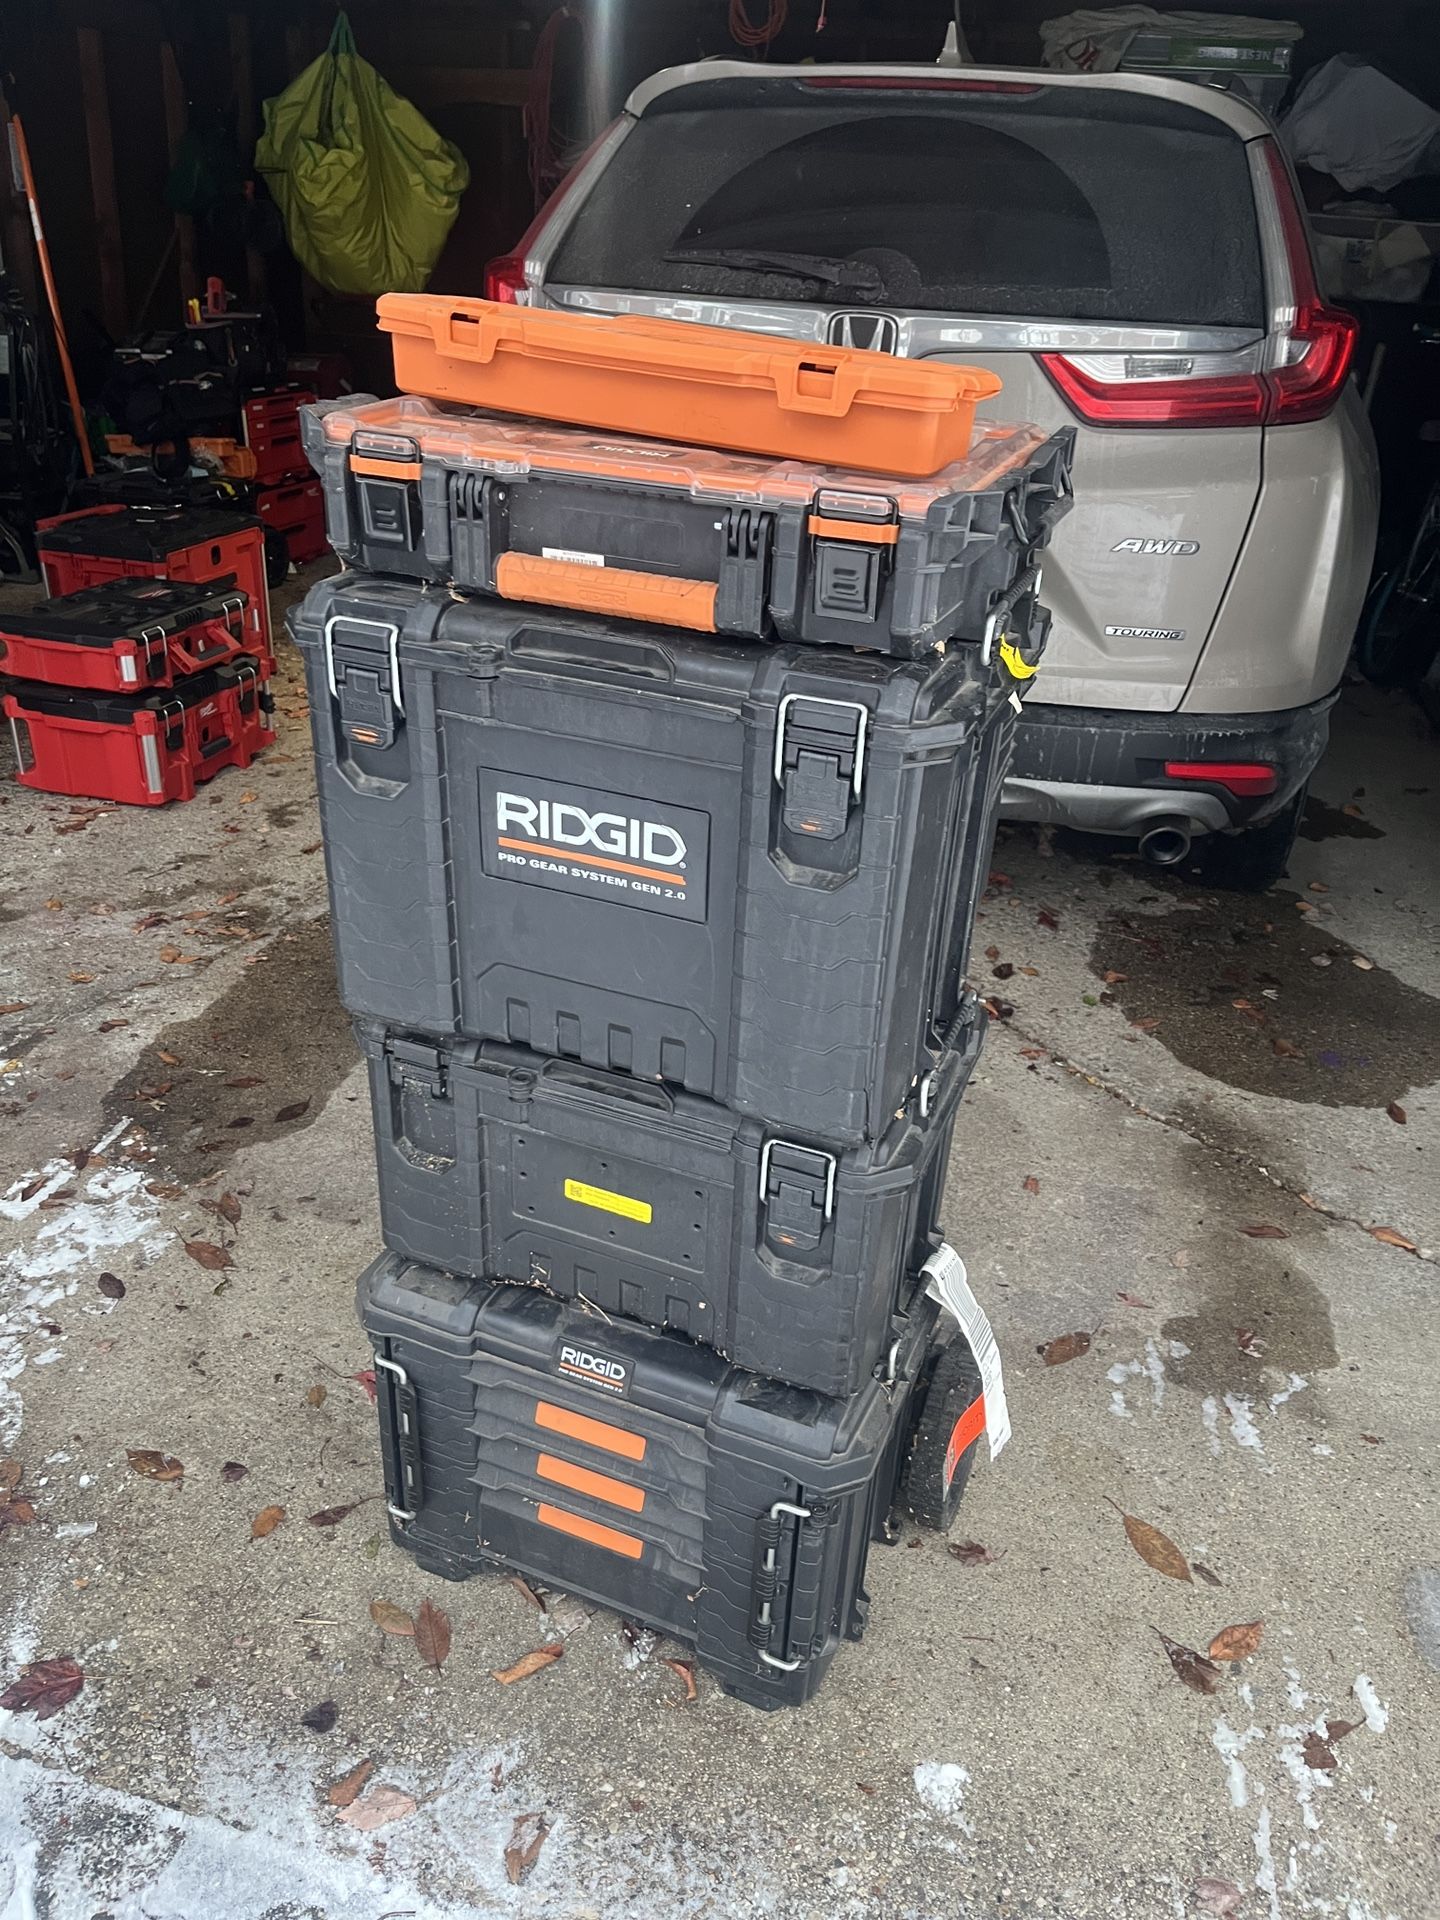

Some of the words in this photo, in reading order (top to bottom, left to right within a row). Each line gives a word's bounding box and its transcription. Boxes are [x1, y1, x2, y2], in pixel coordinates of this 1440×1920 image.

[1110, 538, 1200, 555] AWD
[1111, 627, 1181, 640] TOURING
[496, 791, 687, 866] RIDGID
[498, 852, 527, 866] PRO
[529, 858, 568, 875] GEAR
[571, 868, 628, 889] SYSTEM
[631, 880, 661, 896] GEN
[664, 888, 686, 901] 2.0
[561, 1346, 626, 1380] RIDGID
